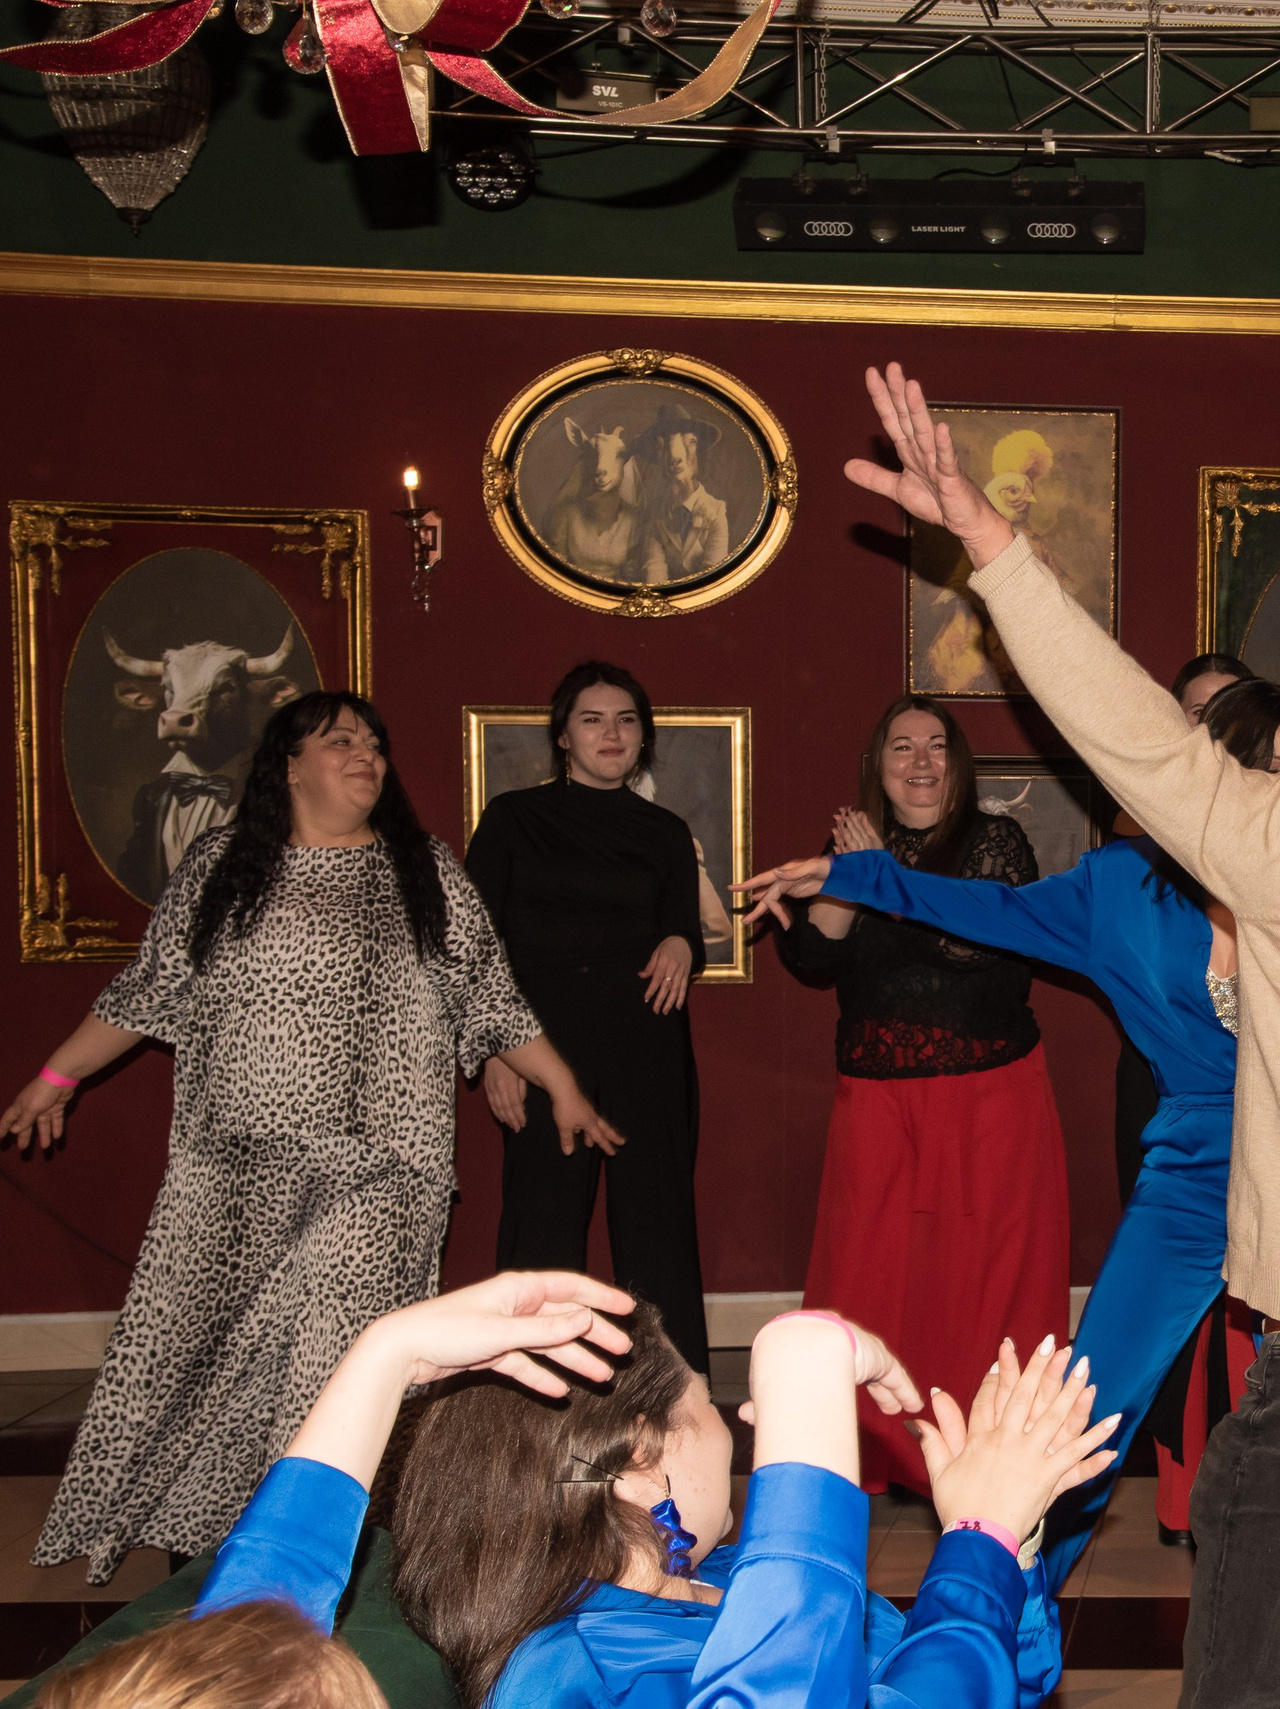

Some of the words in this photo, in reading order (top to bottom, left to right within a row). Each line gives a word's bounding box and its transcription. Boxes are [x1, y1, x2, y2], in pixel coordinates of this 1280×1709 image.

[592, 85, 619, 98] SVL
[598, 101, 623, 109] VS-101C
[911, 225, 939, 233] LASER
